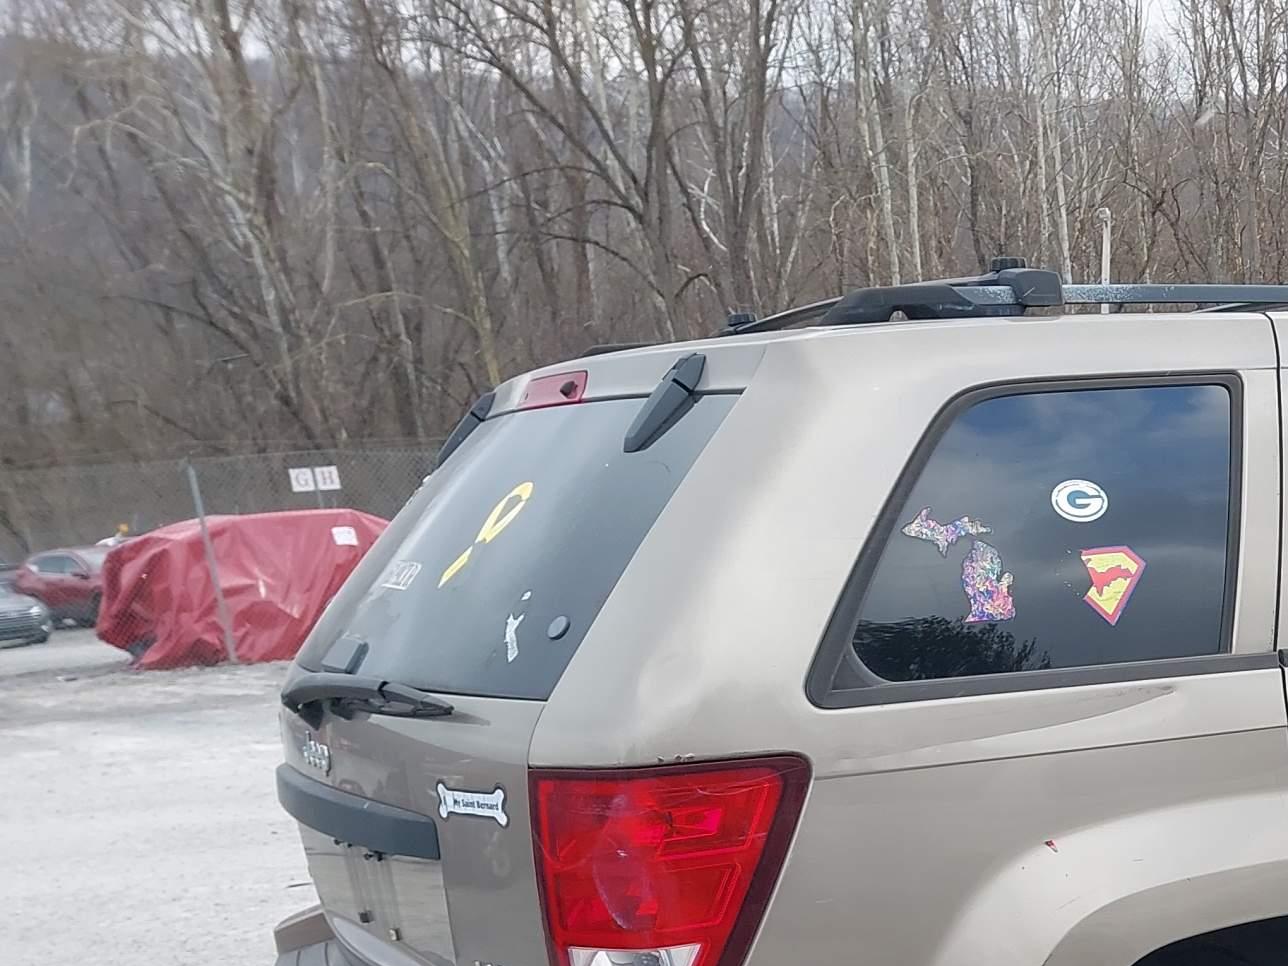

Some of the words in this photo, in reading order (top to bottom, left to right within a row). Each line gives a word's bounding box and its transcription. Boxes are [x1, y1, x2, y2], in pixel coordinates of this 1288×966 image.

[295, 471, 309, 487] G
[320, 470, 335, 486] H
[1055, 483, 1105, 518] G
